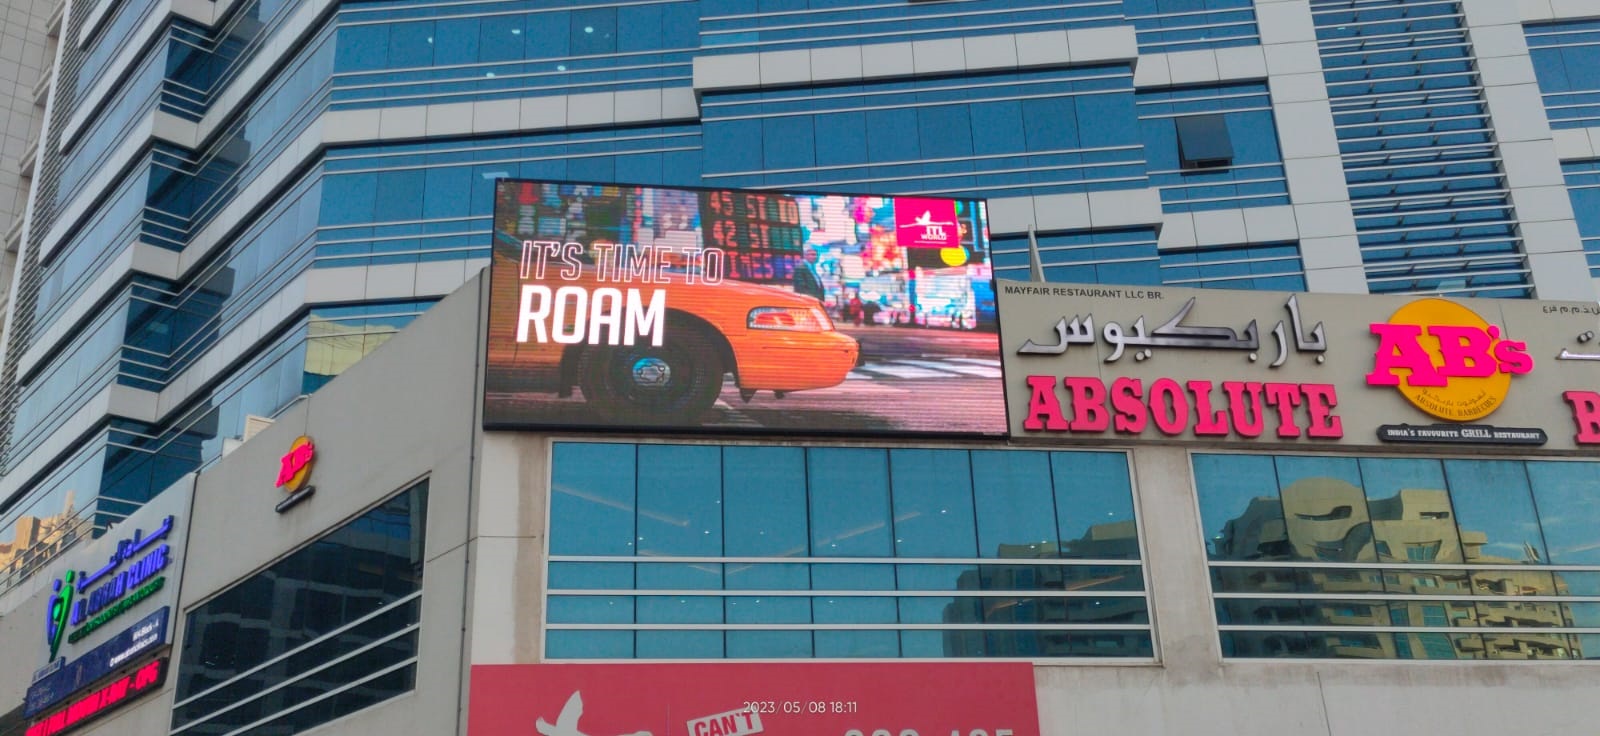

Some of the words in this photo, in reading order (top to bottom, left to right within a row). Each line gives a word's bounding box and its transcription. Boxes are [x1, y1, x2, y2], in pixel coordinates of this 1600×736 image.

[746, 194, 767, 221] ST
[712, 220, 738, 249] 42
[519, 240, 583, 281] IT'S
[594, 243, 673, 284] TIME
[682, 247, 724, 286] TO
[1004, 285, 1050, 296] MAYFAIR
[1052, 287, 1122, 299] RESTAURANT
[1124, 290, 1144, 299] LLC
[1147, 291, 1165, 300] BR.
[516, 284, 667, 348] ROAM
[1022, 374, 1344, 439] ABSOLUTE
[1460, 428, 1492, 438] GRILL
[126, 543, 171, 590] CLINIC
